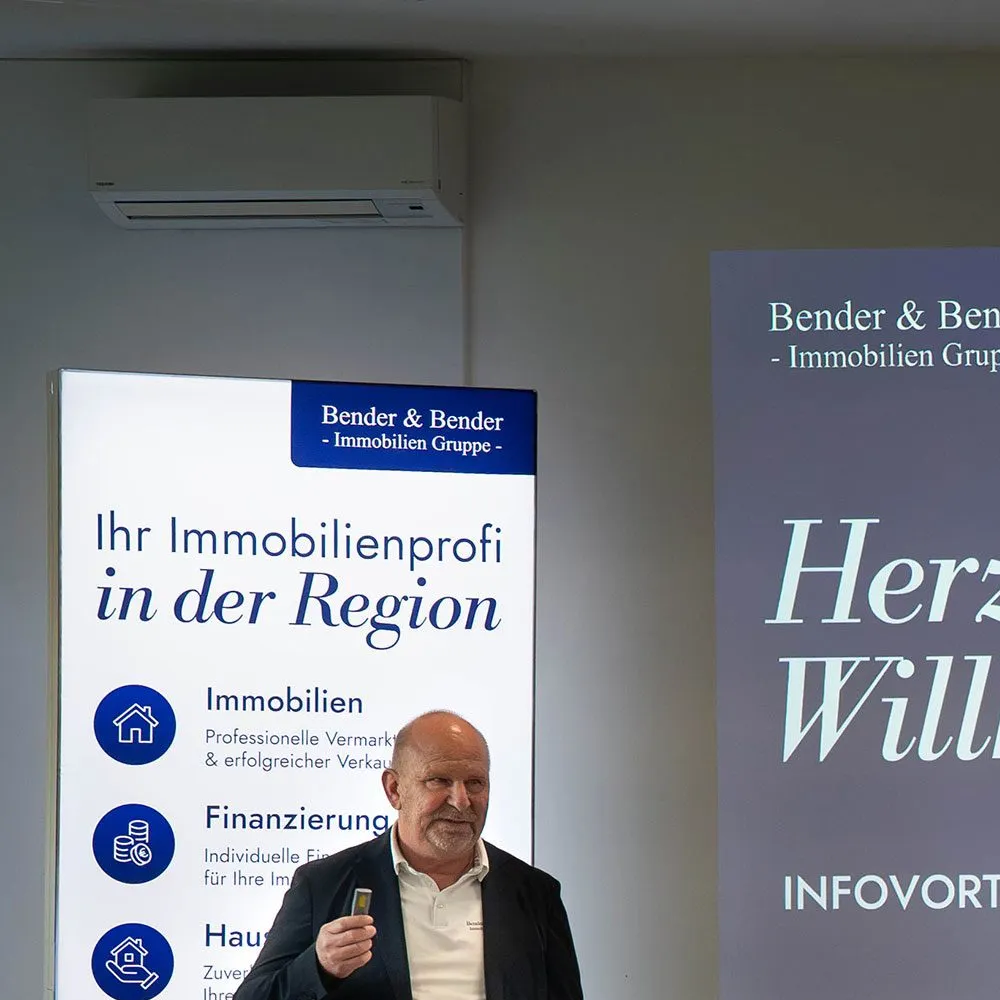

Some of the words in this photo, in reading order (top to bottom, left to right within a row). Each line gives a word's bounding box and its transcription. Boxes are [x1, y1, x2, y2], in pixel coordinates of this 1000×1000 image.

[768, 300, 887, 332] Bender
[896, 299, 927, 331] &
[789, 343, 935, 369] Immobilien
[321, 404, 398, 427] Bender
[403, 408, 424, 428] &
[429, 409, 504, 431] Bender
[334, 431, 428, 451] Immobilien
[431, 435, 491, 457] Gruppe
[97, 509, 152, 552] Ihr
[171, 516, 502, 569] Immobilienprofi
[96, 566, 158, 622] in
[173, 568, 277, 625] der
[288, 571, 502, 651] Region
[207, 685, 363, 714] Immobilien
[205, 727, 320, 746] Professionelle
[205, 751, 218, 767] &
[224, 750, 331, 773] erfolgreicher
[206, 805, 389, 837] Finanzierung
[204, 846, 300, 864] Individuelle
[204, 868, 227, 887] für
[233, 869, 265, 887] Ihre
[205, 923, 270, 947] Hau
